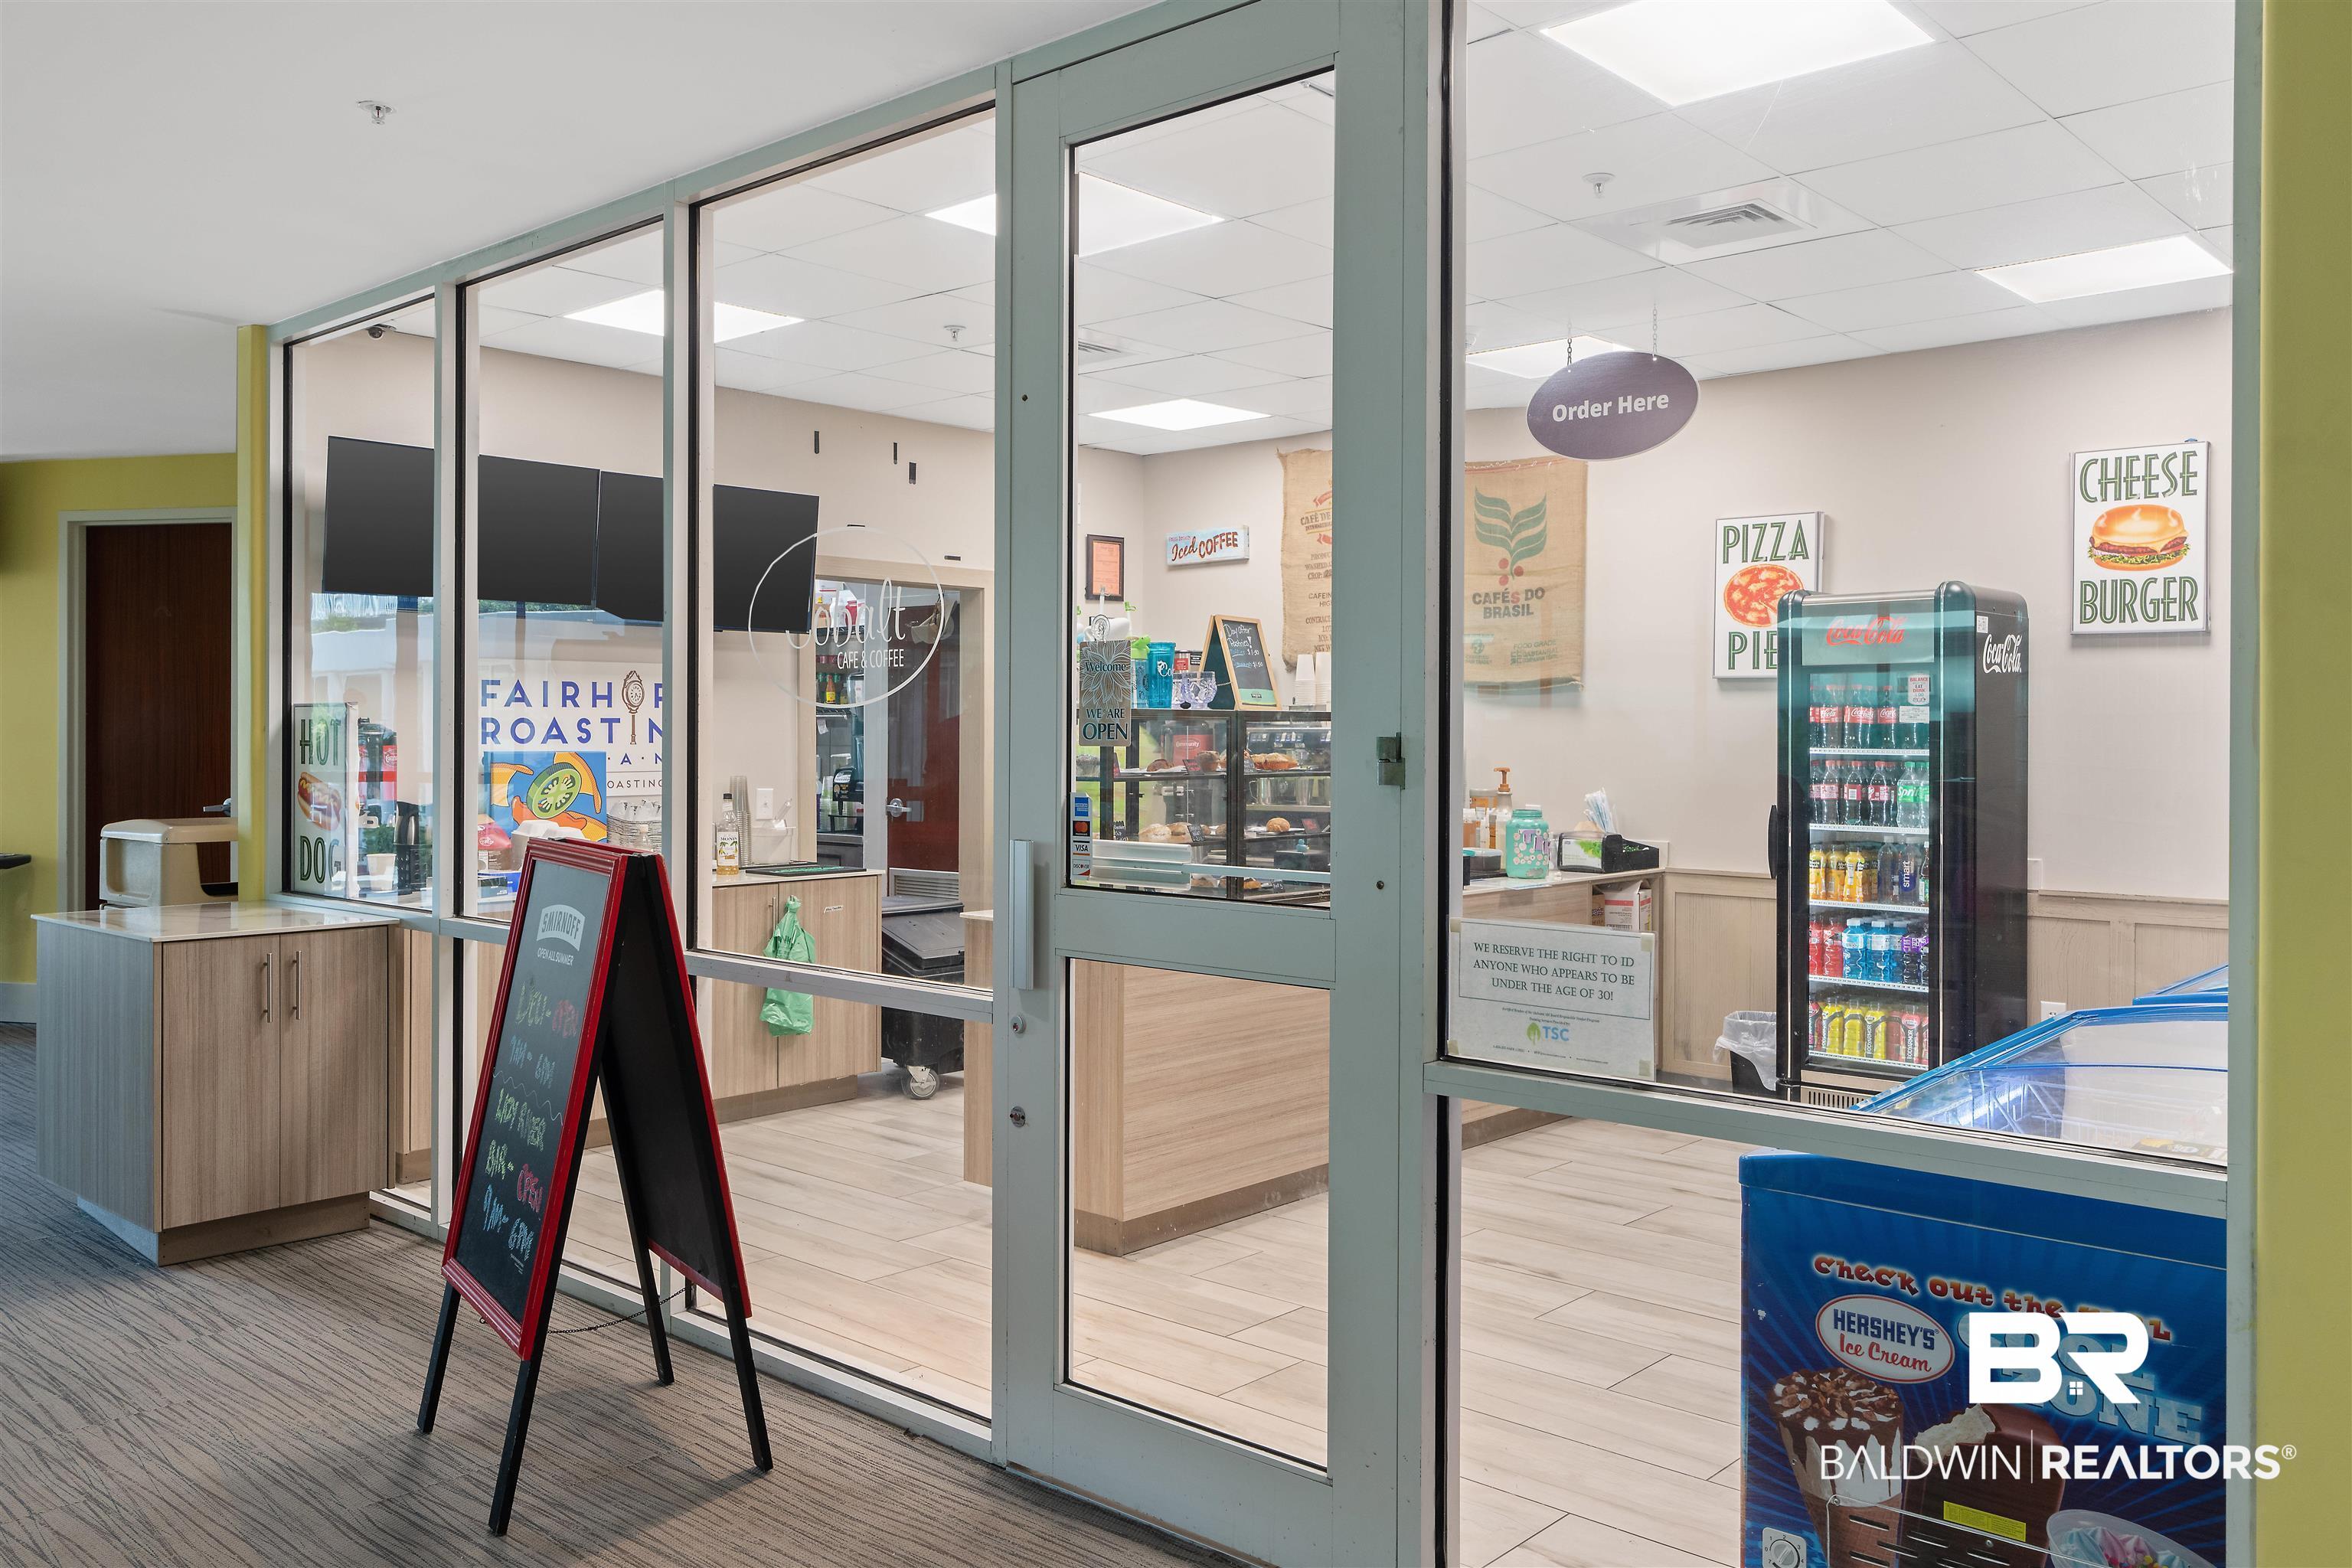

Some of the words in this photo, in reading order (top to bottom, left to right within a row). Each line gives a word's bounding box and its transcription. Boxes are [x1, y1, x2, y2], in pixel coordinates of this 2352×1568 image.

[1552, 398, 1612, 422] Order
[1618, 394, 1669, 415] Here
[2079, 450, 2197, 503] CHEESE
[1171, 536, 1197, 561] Iced
[1198, 531, 1238, 558] COFFEE
[1723, 520, 1809, 564] PIZZA
[1472, 588, 1520, 605] CAFÉS
[1524, 587, 1545, 600] DO
[2079, 576, 2198, 624] BURGER
[1483, 603, 1534, 619] BRASIL
[1223, 624, 1238, 638] Day
[837, 651, 858, 669] CAFE
[861, 651, 868, 668] &
[870, 649, 904, 668] COFFEE
[1086, 661, 1126, 671] Welcome
[1982, 633, 2022, 674] Coca-Cola
[1086, 708, 1102, 718] WE
[1107, 708, 1125, 718] ARE
[299, 718, 341, 766] HOT
[1083, 723, 1128, 740] OPEN
[299, 835, 341, 884] DOG
[541, 910, 580, 939] SMIRNOFF
[537, 947, 548, 959] OPEN
[556, 952, 573, 966] SUMMER
[1473, 942, 1490, 953] WE
[1492, 944, 1534, 958] RESERVE
[1537, 948, 1559, 960] THE
[1561, 951, 1598, 964] RIGHT
[1601, 955, 1618, 967] TO
[1621, 957, 1635, 968] ID
[1473, 959, 1518, 973] ANYONE
[1521, 964, 1548, 976] WHO
[1551, 968, 1598, 982] APPEARS
[1601, 972, 1617, 984] TO
[1621, 975, 1635, 985] BE
[1491, 978, 1527, 991] UNDER
[1530, 982, 1552, 994] THE
[1555, 985, 1576, 997] AGE
[1579, 988, 1594, 999] OF
[1597, 990, 1613, 1001] 30!
[1542, 1026, 1570, 1041] TSC
[516, 1163, 545, 1213] OPEN
[1929, 1277, 1994, 1307] out
[2003, 1290, 2064, 1319] the
[1840, 1334, 1865, 1357] Ice
[1868, 1338, 1932, 1373] Cream
